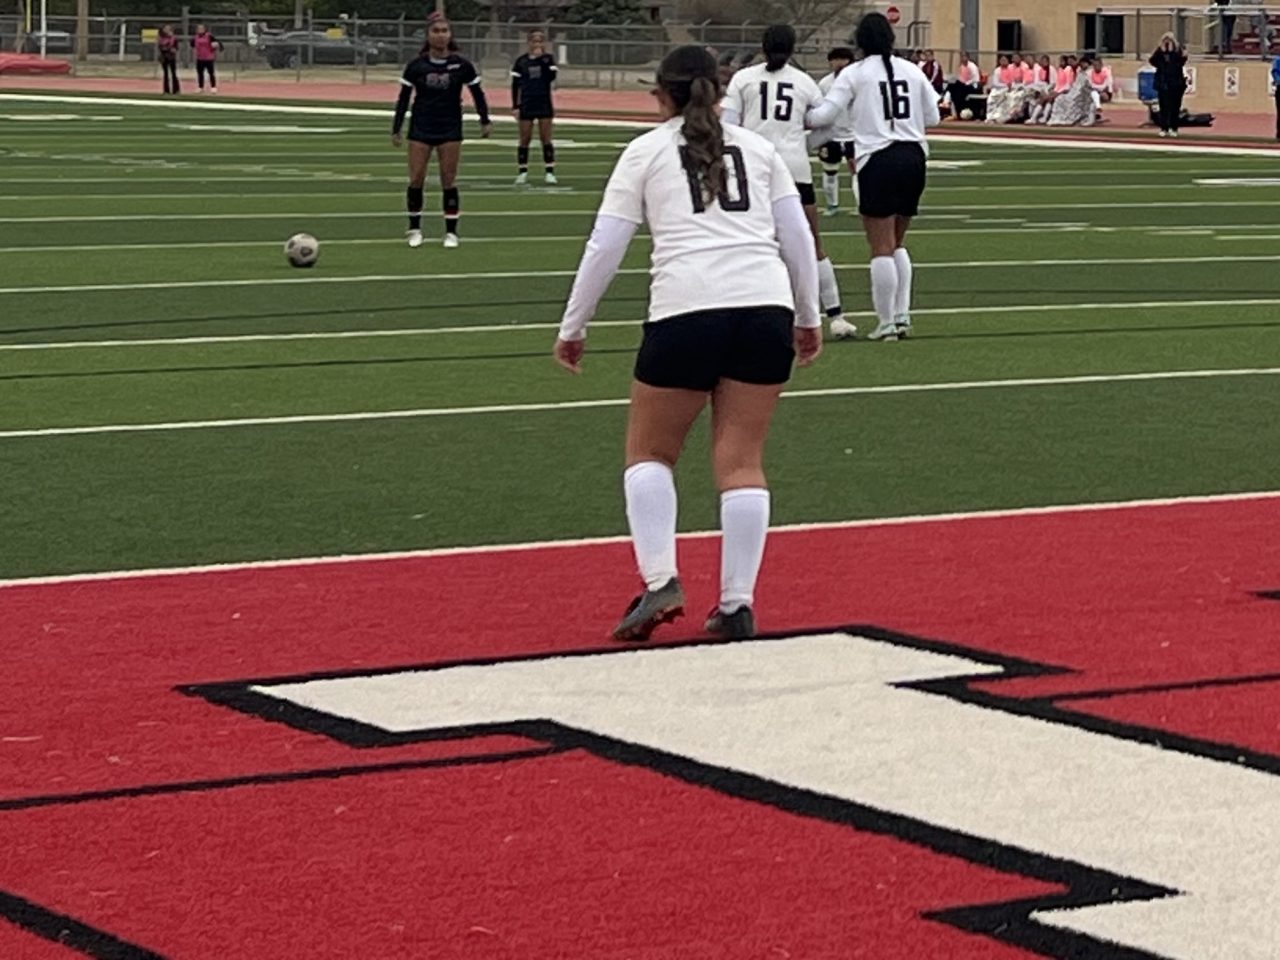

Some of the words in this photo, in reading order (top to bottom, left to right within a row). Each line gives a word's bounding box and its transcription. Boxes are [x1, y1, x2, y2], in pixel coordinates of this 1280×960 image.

[759, 80, 794, 121] 15
[879, 79, 911, 121] 16
[678, 144, 751, 214] 10
